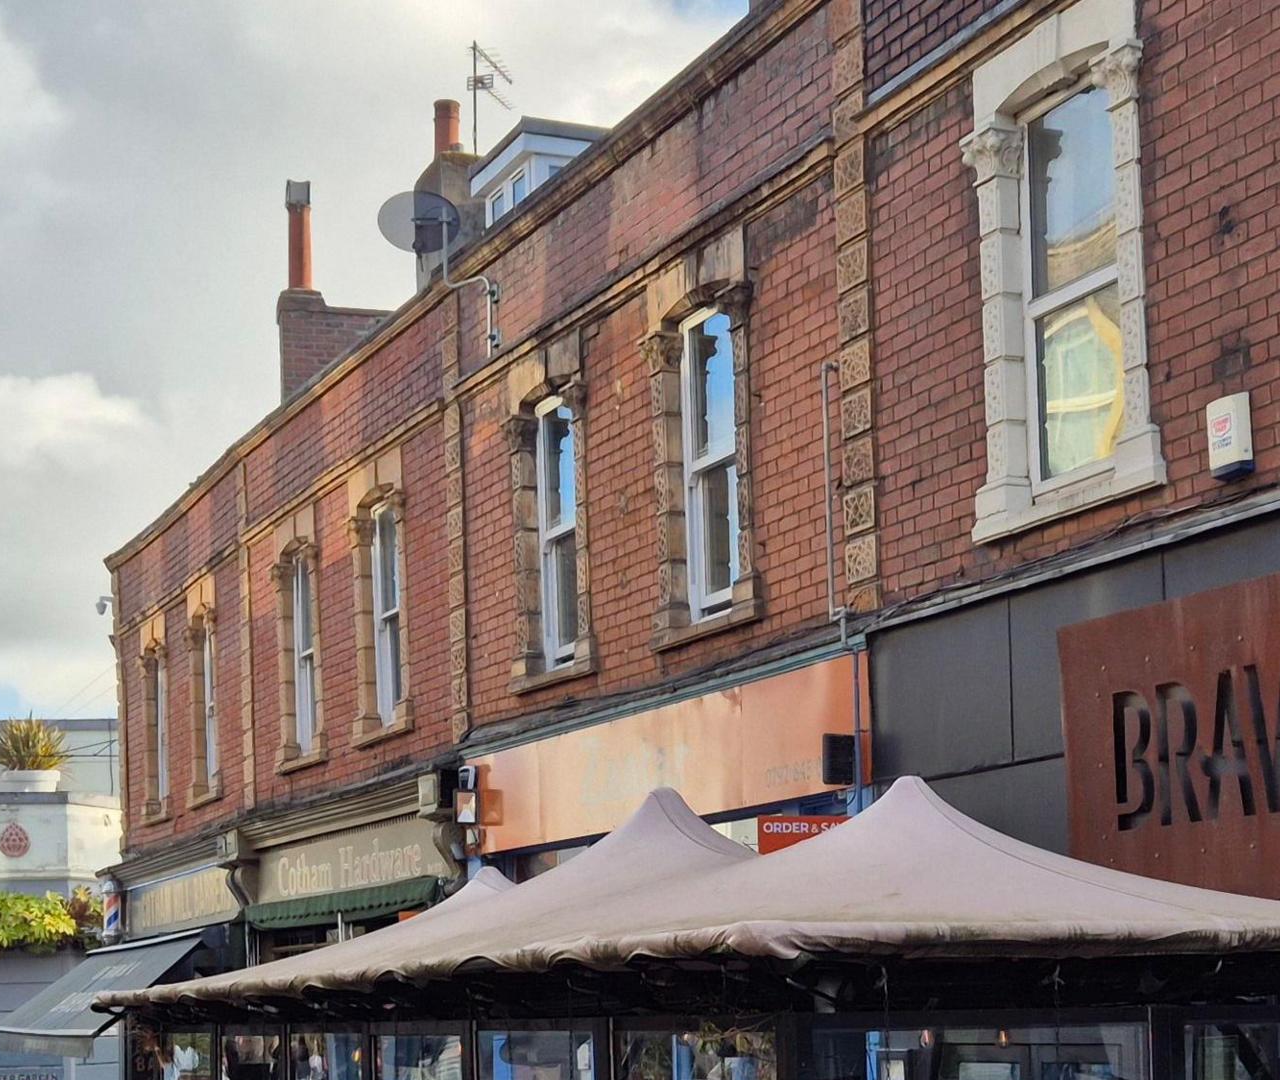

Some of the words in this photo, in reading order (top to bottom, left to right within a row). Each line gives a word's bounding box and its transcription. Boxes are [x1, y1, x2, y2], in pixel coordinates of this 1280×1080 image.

[762, 821, 809, 834] ORDER
[810, 823, 819, 833] &
[278, 852, 334, 897] Cotham
[337, 838, 422, 888] Hardware
